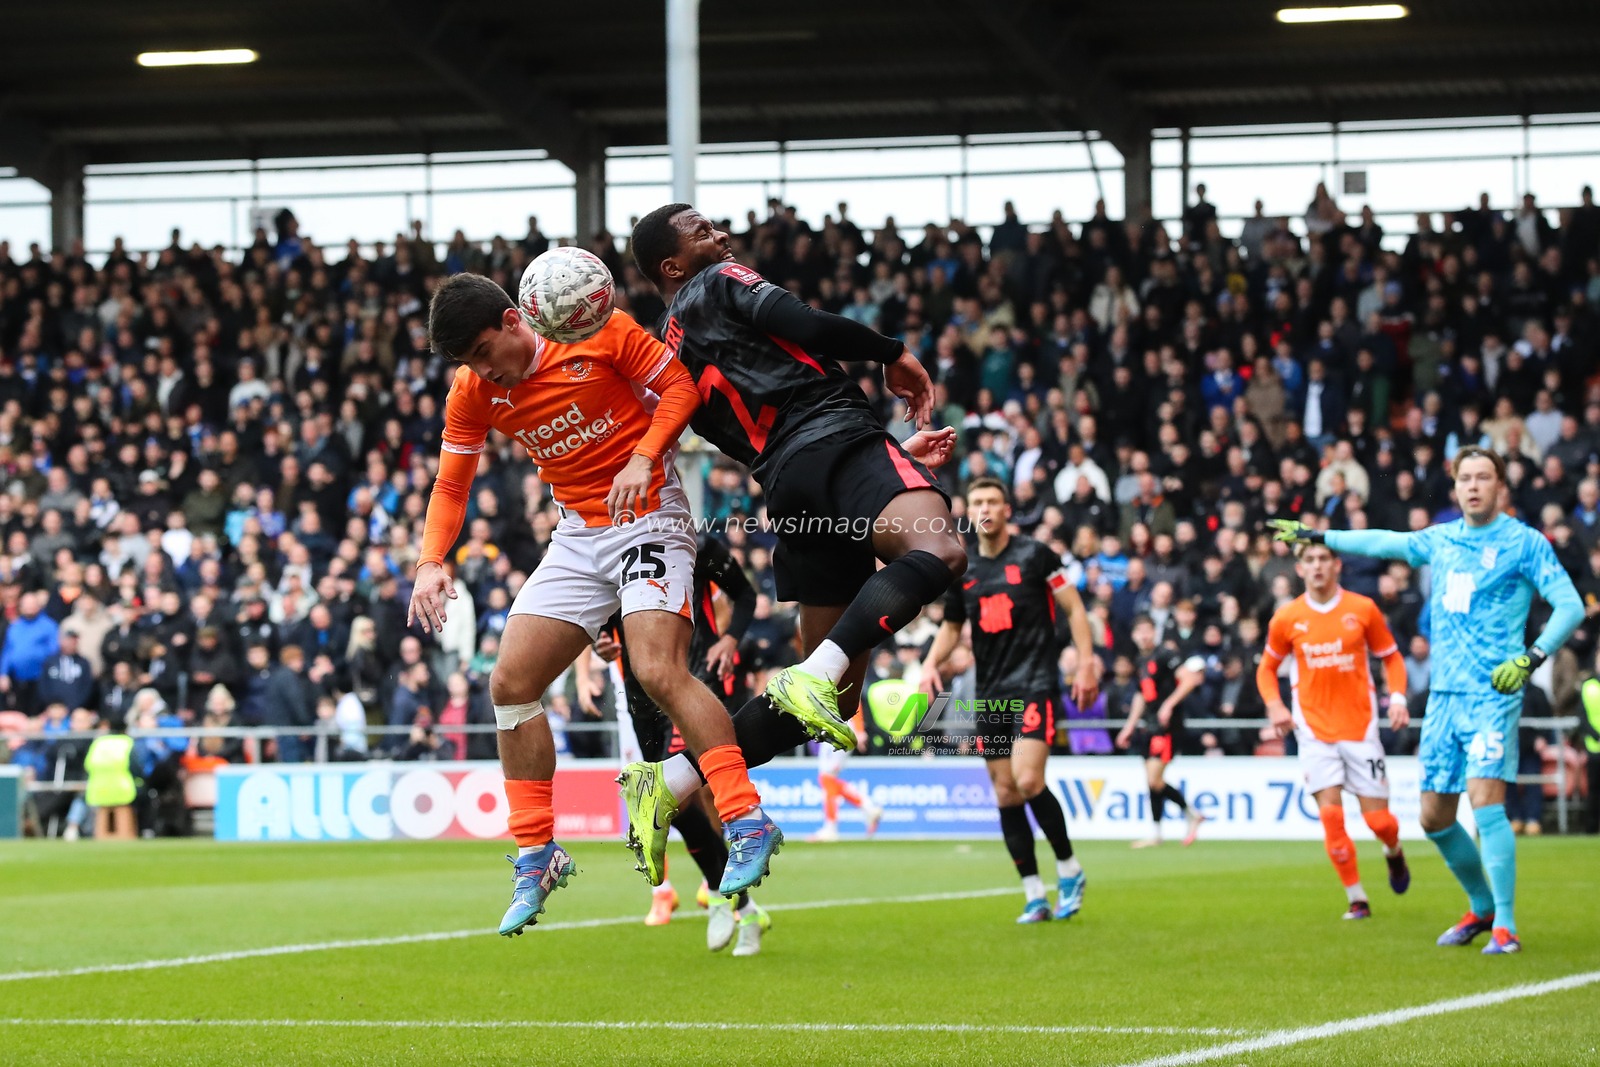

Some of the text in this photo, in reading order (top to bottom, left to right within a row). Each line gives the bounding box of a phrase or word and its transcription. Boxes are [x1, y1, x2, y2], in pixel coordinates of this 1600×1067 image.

[514, 402, 586, 446] Tread
[531, 408, 614, 459] Tracker
[621, 543, 667, 586] 25
[1022, 702, 1042, 727] 6
[1467, 731, 1504, 761] 45
[1366, 759, 1386, 779] 19
